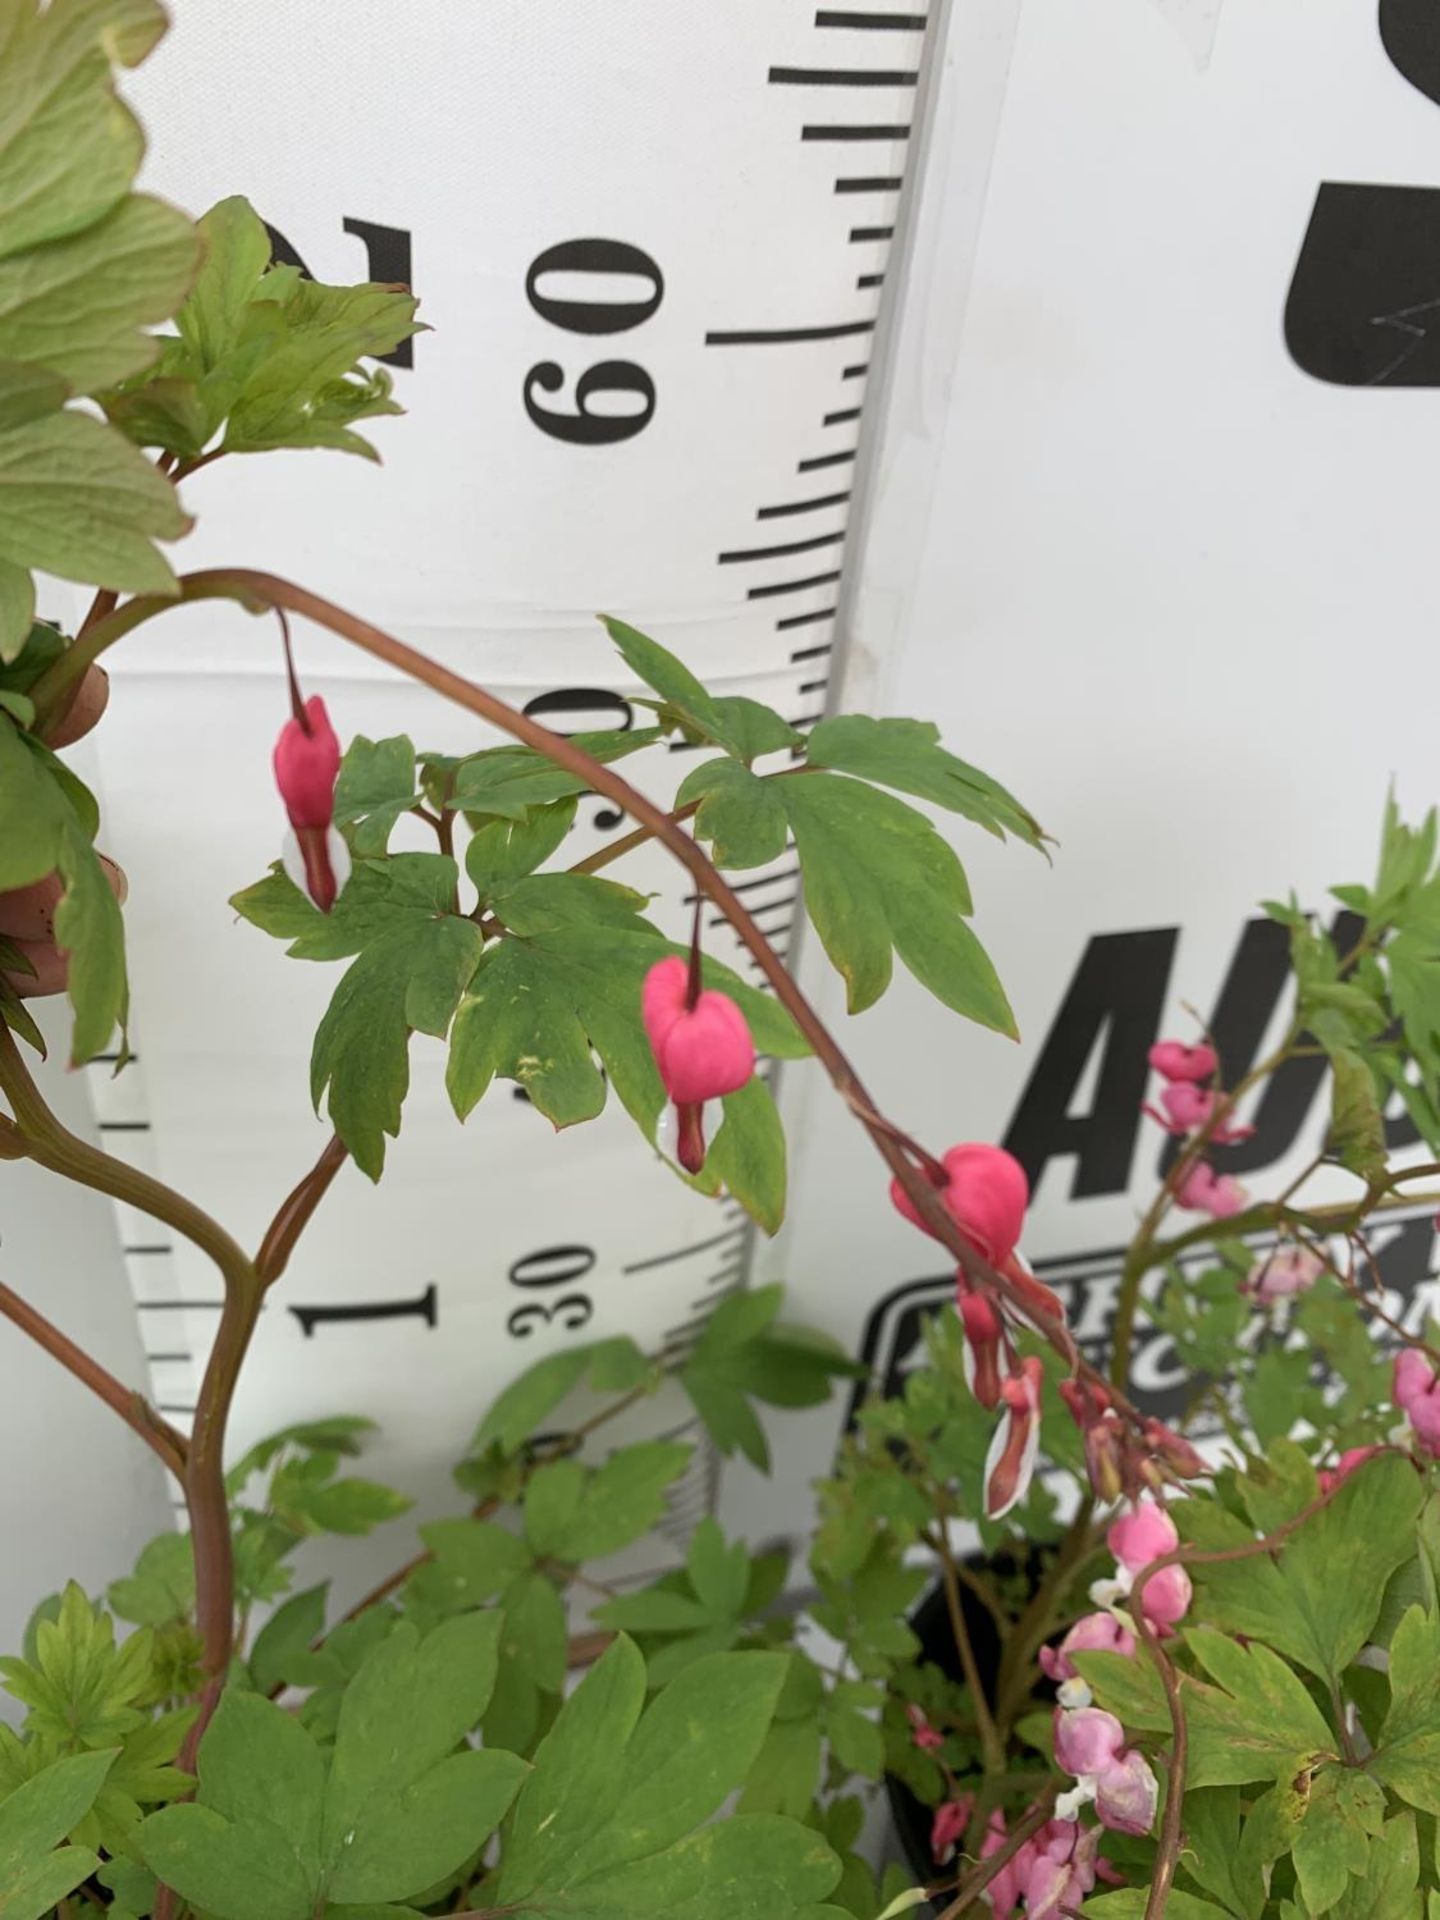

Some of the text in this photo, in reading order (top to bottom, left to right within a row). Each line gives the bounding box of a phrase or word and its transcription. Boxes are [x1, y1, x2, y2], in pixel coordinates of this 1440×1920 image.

[524, 237, 665, 446] 60
[287, 1281, 438, 1338] 1
[508, 1245, 597, 1339] 30
